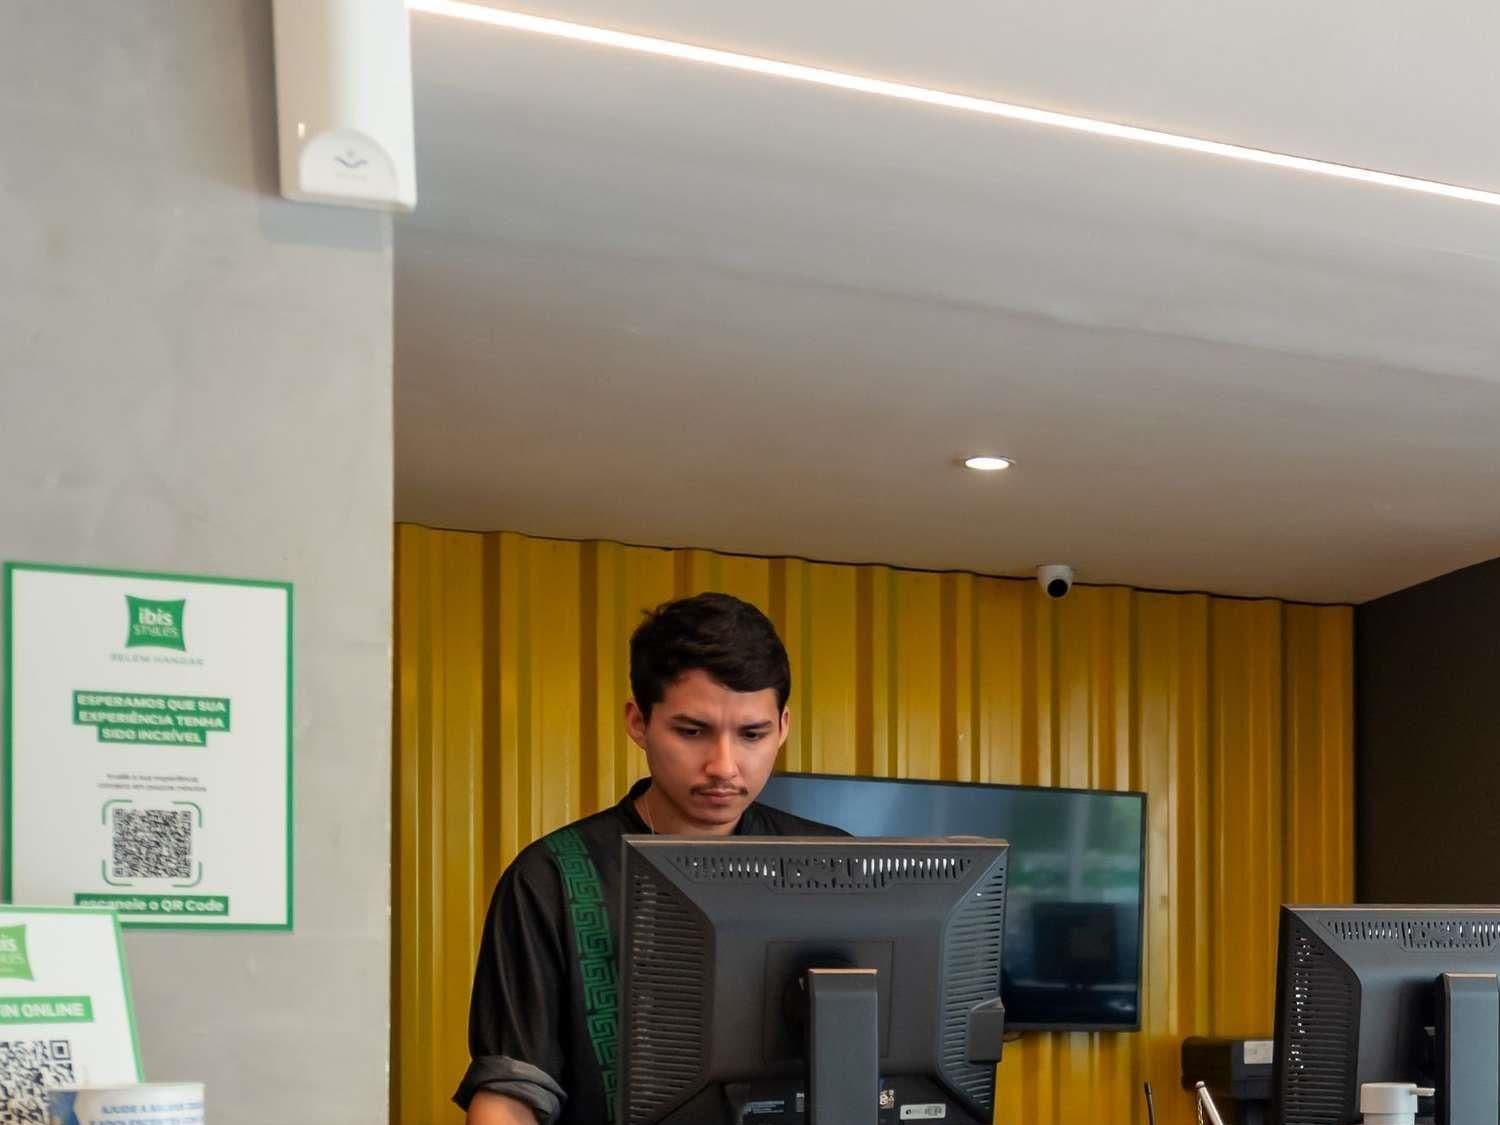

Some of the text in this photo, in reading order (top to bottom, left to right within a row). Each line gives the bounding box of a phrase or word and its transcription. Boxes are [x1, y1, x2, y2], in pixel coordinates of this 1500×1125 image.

[138, 607, 173, 626] ibis
[133, 624, 179, 638] STYLES
[77, 694, 226, 713] ESPERAMOS QUE SUA
[79, 710, 225, 728] EXPERIÊNCIA TENHA
[102, 727, 202, 744] SIDO INCRÍVEL
[149, 900, 159, 911] o
[161, 899, 184, 912] QR
[185, 899, 224, 912] Code
[21, 1002, 85, 1018] ONLINE
